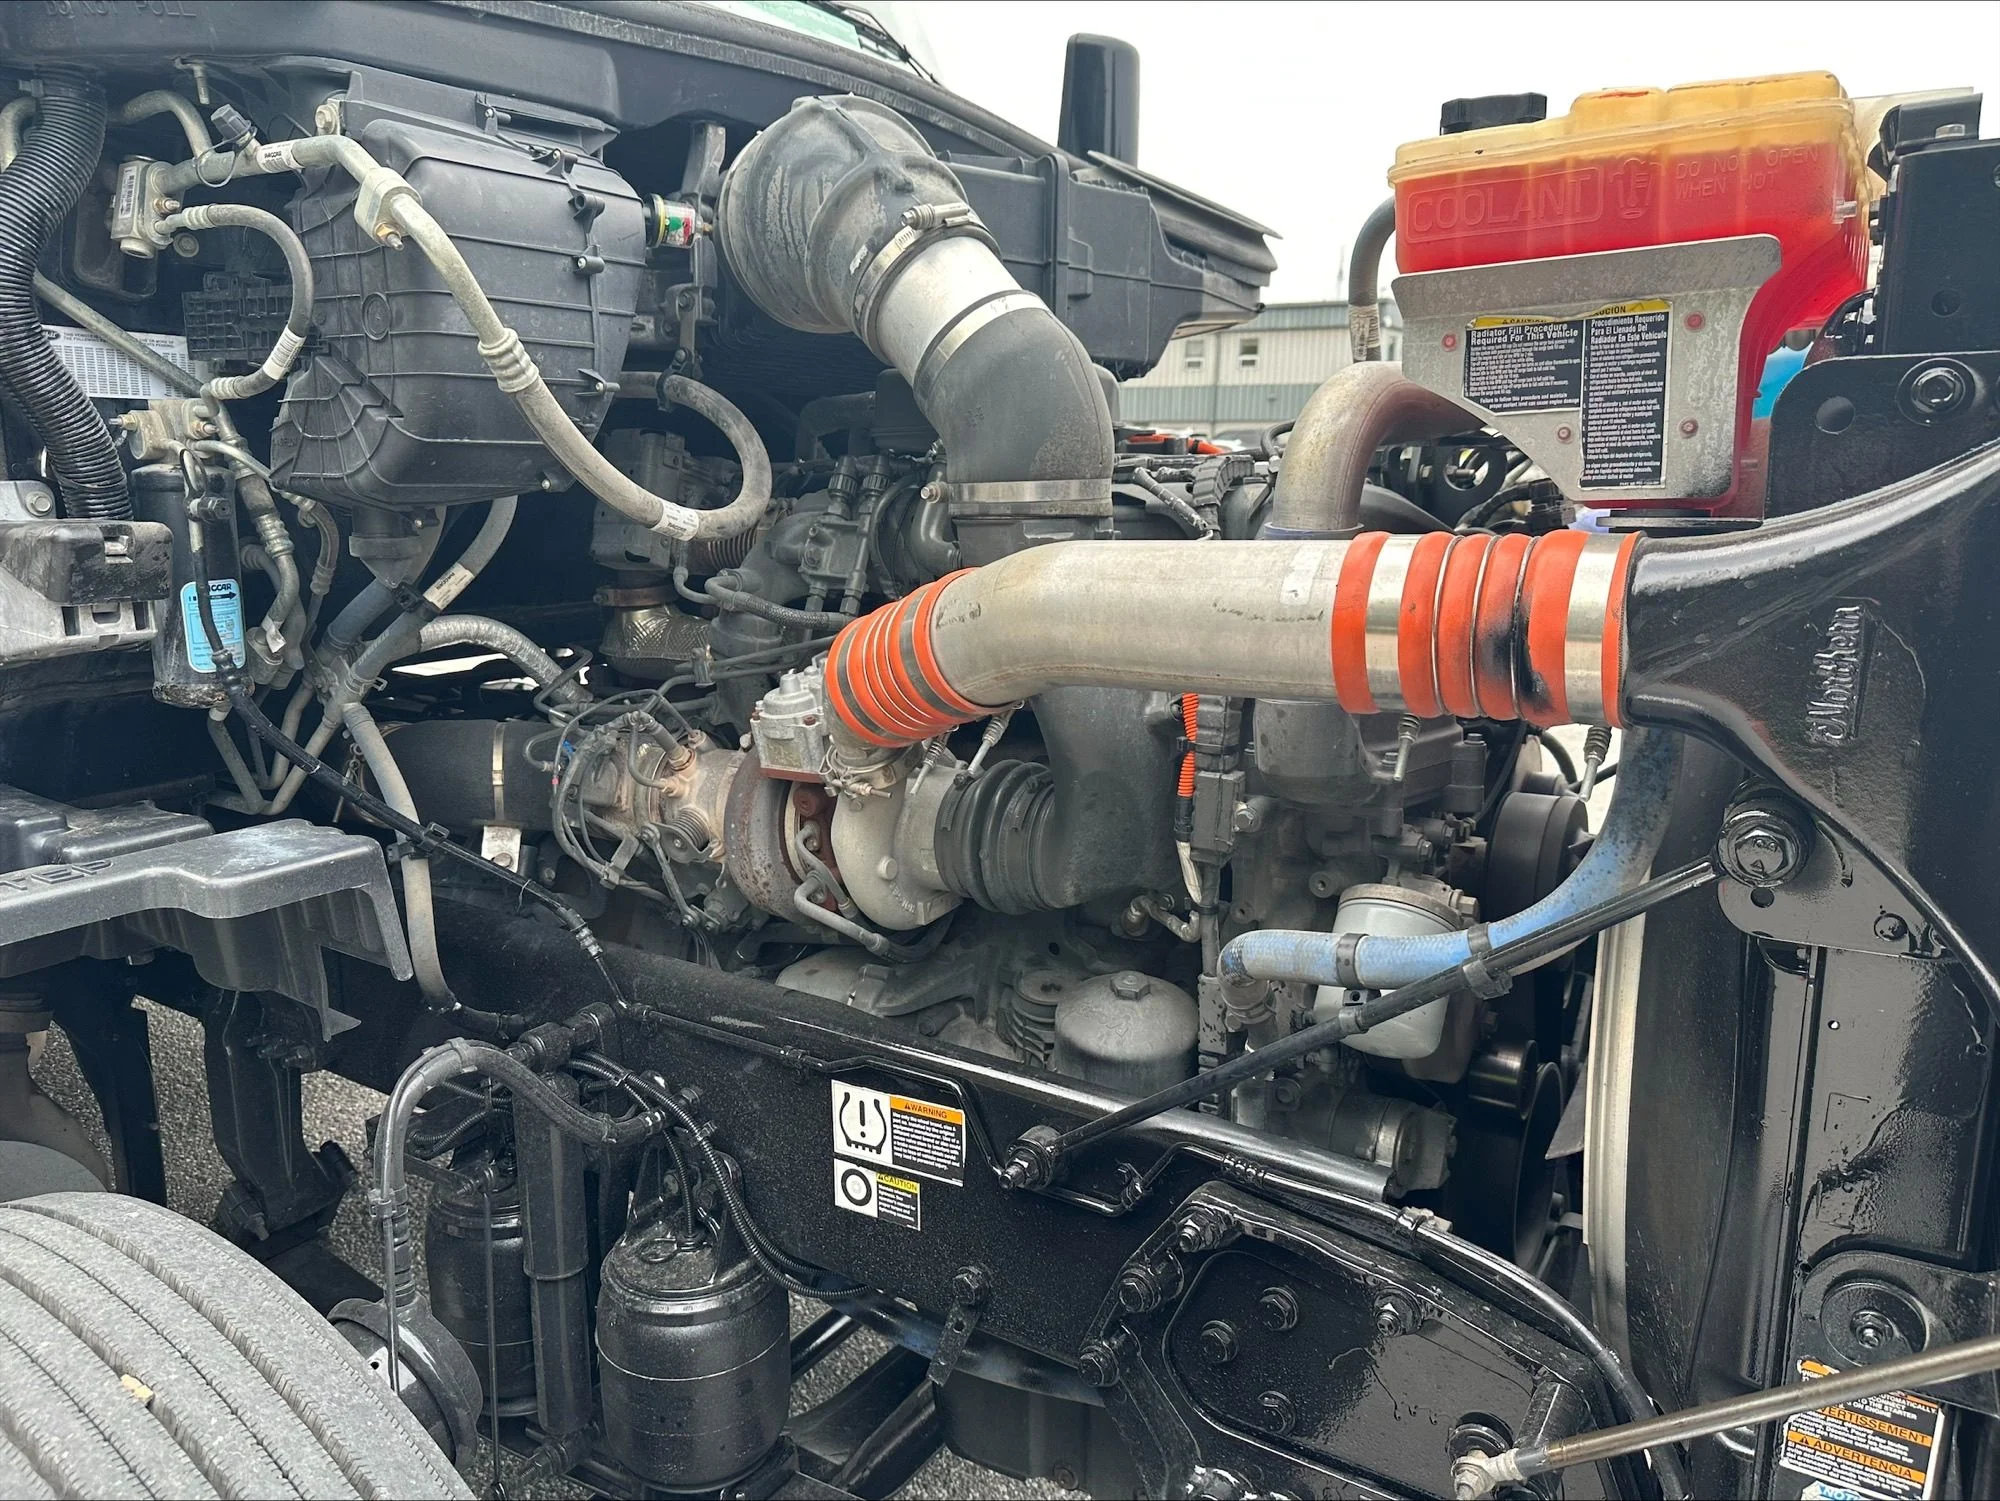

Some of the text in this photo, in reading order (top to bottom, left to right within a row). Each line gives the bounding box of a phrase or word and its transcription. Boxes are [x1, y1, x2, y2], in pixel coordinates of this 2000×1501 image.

[1413, 174, 1592, 233] COOLANT
[1591, 314, 1665, 328] Procedimiento Requerido
[1591, 327, 1605, 336] Para
[1613, 325, 1637, 334] Llenado
[1638, 323, 1648, 332] Del
[1471, 323, 1568, 339] Radiator Fill Procedure
[1471, 328, 1579, 346] Required For This Vehicle
[910, 1103, 948, 1119] WARNING
[884, 1174, 917, 1191] CAUTION
[1852, 1401, 1892, 1419] ON ENGINE
[1868, 1400, 1884, 1410] THE
[1884, 1405, 1918, 1420] STARTER
[1879, 1392, 1938, 1415] UTOMATICALLY.
[1819, 1406, 1930, 1444] VERTISSEMENT
[1813, 1440, 1913, 1479] ADVERTENCIA
